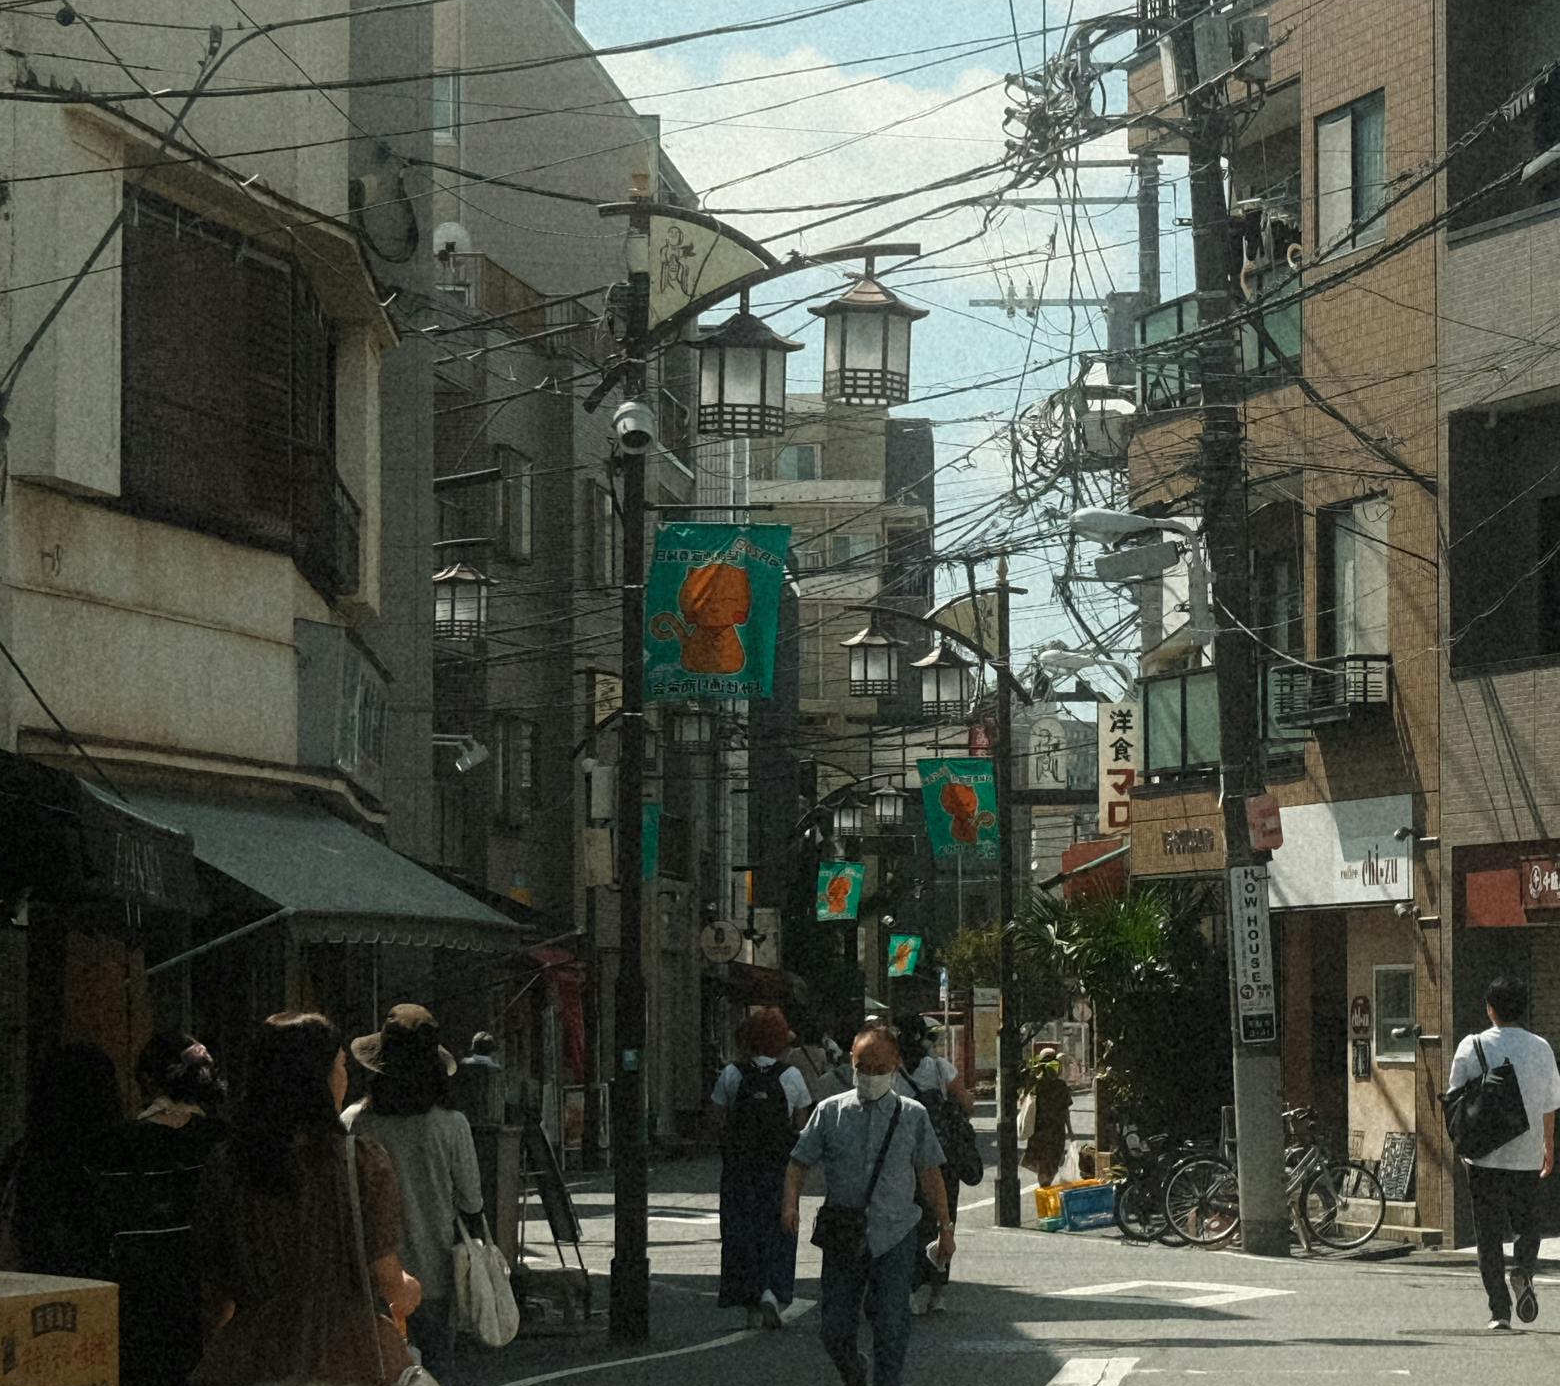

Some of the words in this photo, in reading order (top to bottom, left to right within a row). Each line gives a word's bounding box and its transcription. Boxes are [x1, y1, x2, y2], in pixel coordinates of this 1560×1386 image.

[1109, 709, 1133, 762] 洋食
[1243, 868, 1259, 908] HOW
[1247, 916, 1262, 983] HOUSE
